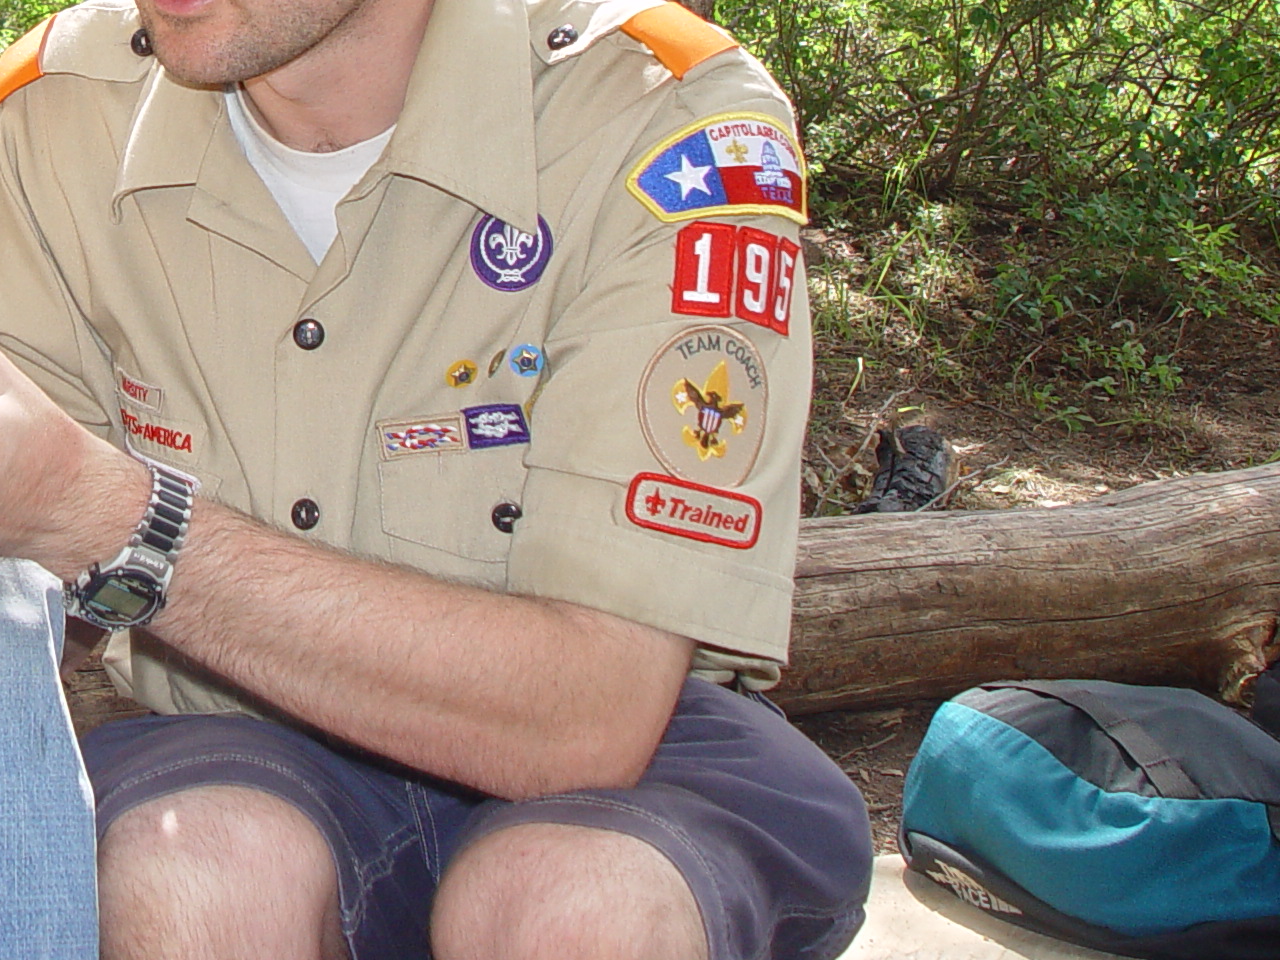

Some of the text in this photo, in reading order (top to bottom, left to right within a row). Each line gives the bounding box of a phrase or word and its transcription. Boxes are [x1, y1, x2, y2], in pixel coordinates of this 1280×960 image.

[709, 123, 755, 142] CAPITOL
[682, 232, 794, 321] 195
[675, 334, 762, 390] TEAM COACH
[143, 423, 192, 453] AMERICA
[669, 497, 749, 534] Trained
